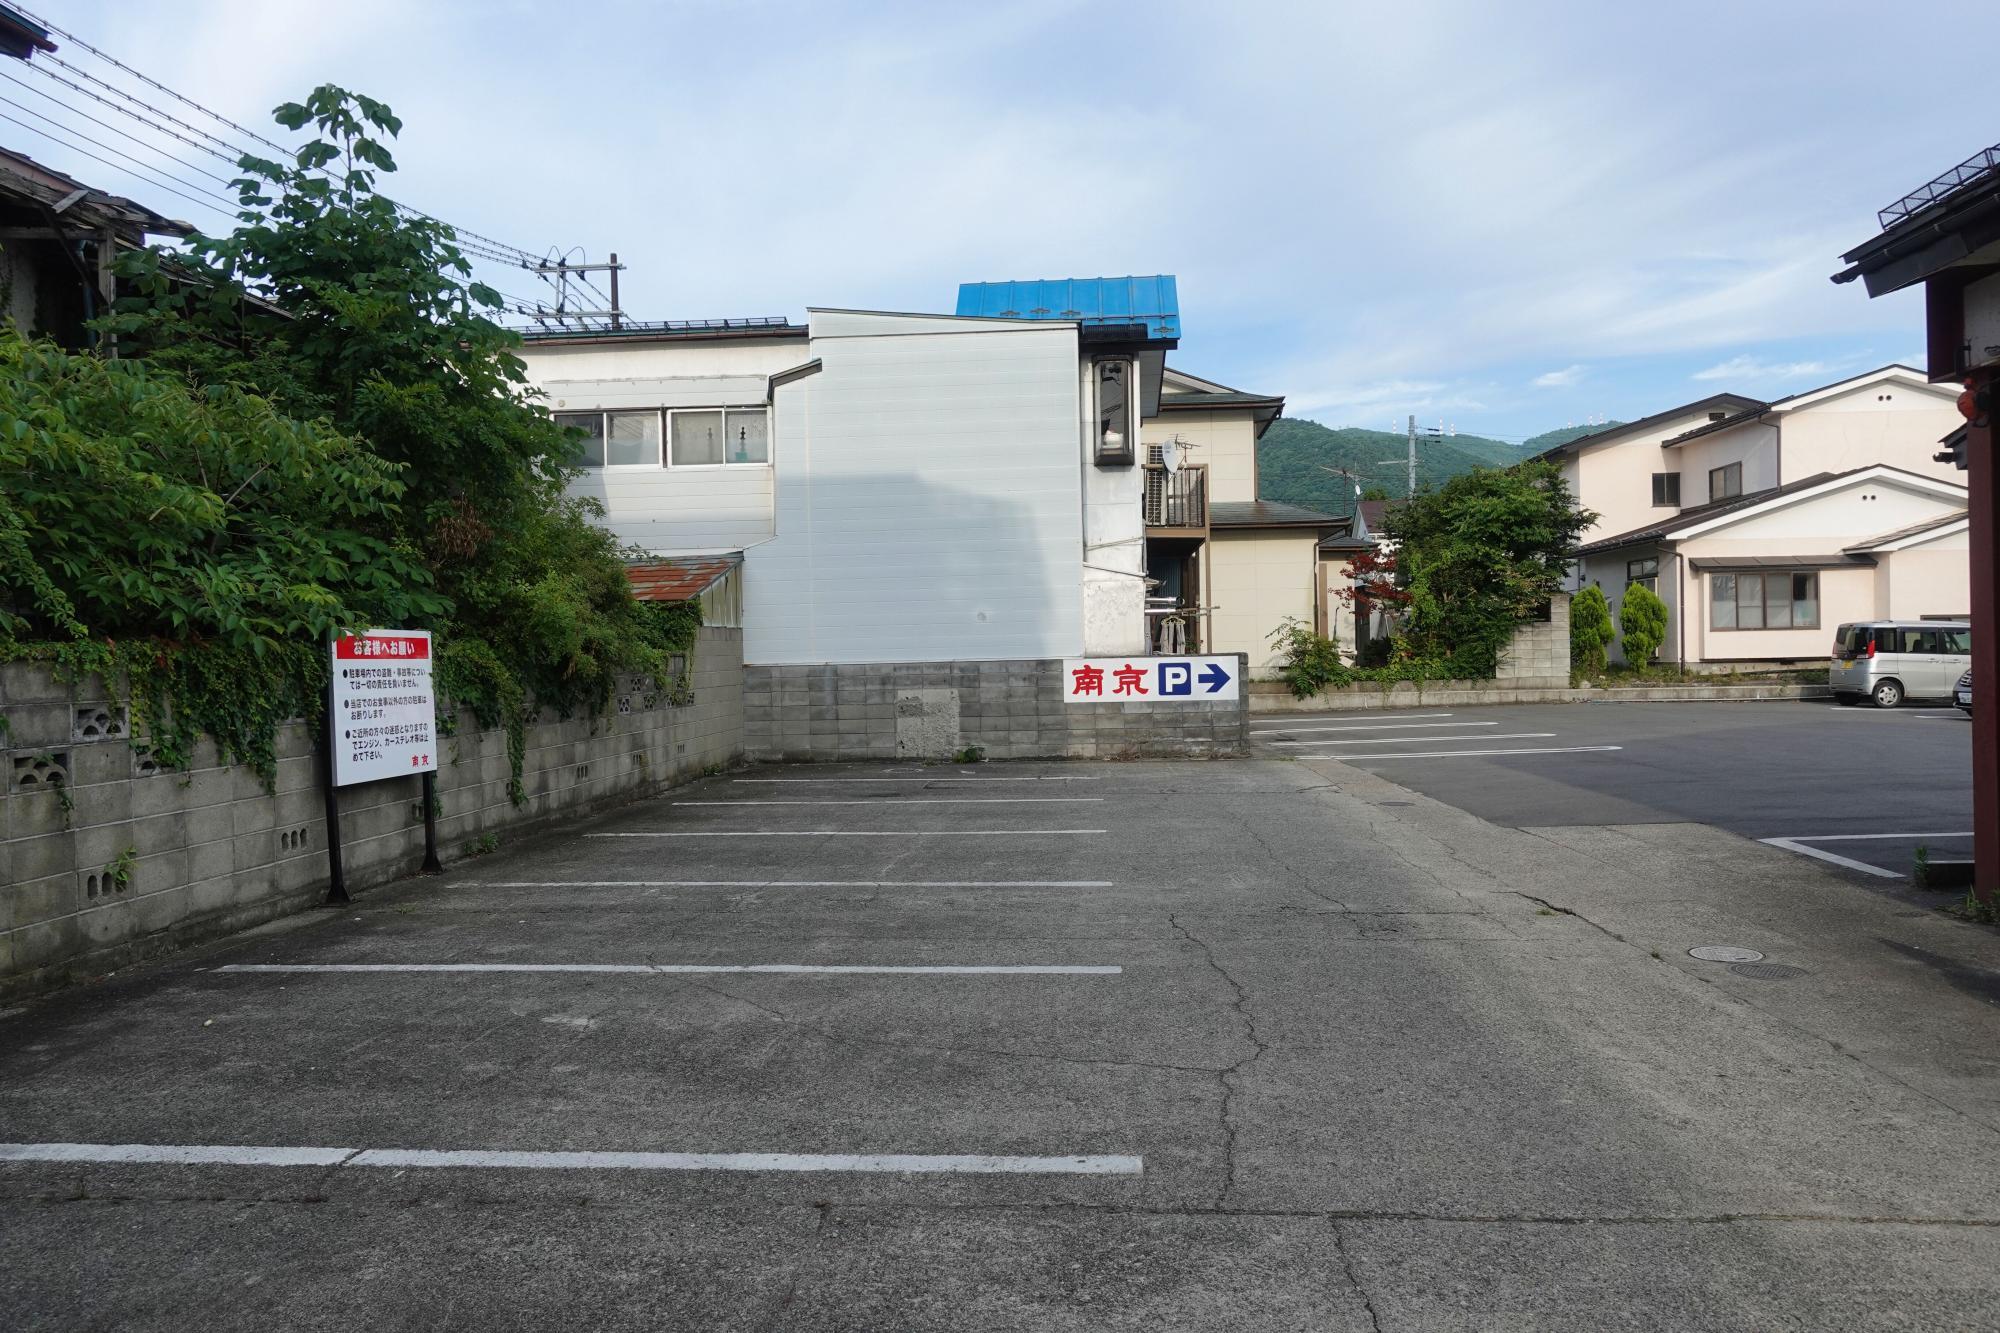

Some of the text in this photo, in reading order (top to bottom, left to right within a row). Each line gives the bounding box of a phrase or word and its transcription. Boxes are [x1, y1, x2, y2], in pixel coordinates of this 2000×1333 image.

[353, 640, 415, 655] お客様へお願い
[349, 679, 419, 690] ては一切の責任を負いません。
[1072, 664, 1188, 696] 南京 P
[350, 696, 427, 709] 当店でのお食事以外の方の駐車は
[351, 709, 386, 720] お断りします。
[352, 750, 383, 762] めて下さい。
[412, 754, 429, 767] 南京
